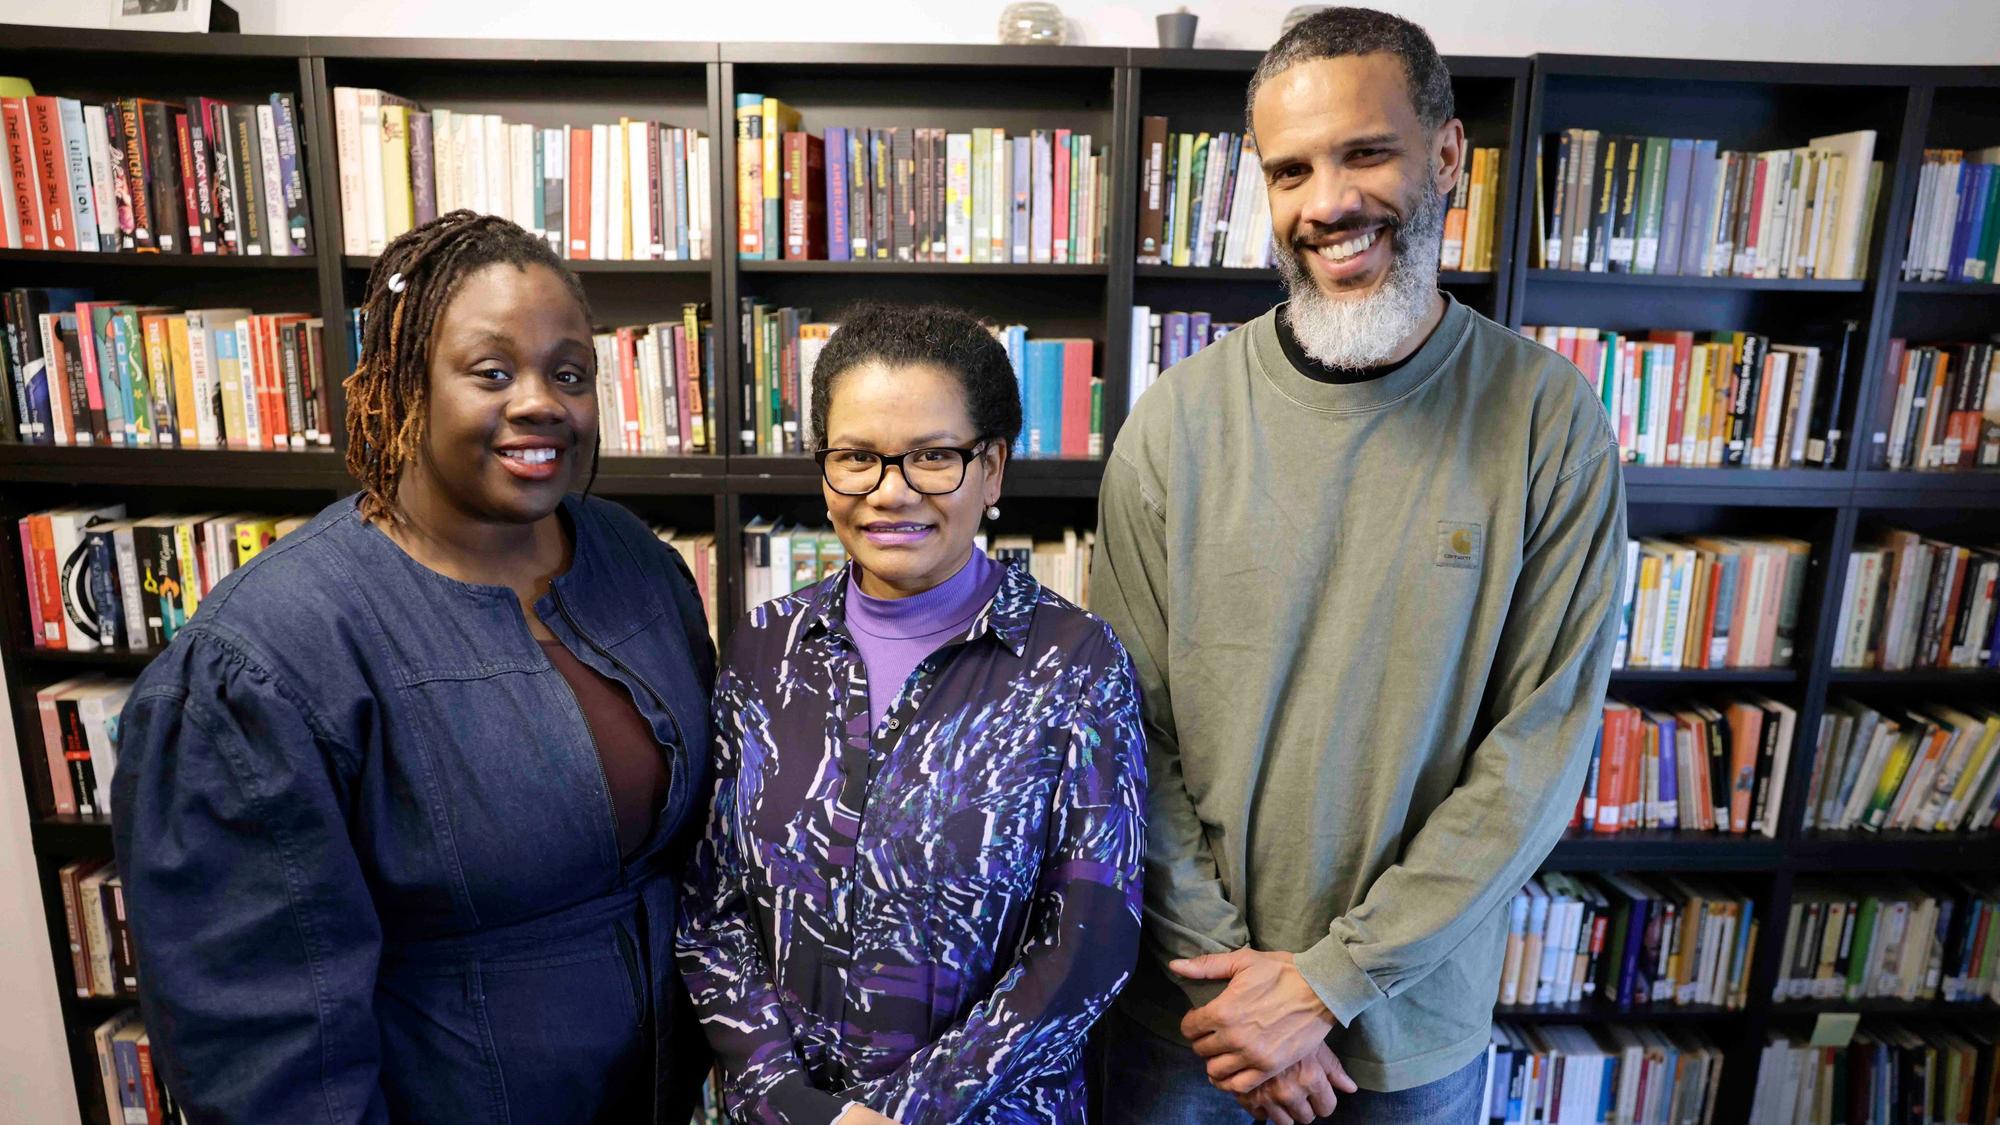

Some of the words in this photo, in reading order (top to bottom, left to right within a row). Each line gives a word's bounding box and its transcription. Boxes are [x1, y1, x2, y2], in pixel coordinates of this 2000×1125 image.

[7, 115, 20, 140] THE
[36, 105, 49, 133] GIVE
[123, 112, 137, 138] BAD
[41, 138, 51, 146] U
[12, 145, 26, 178] HATE
[43, 149, 54, 178] HATE
[127, 140, 143, 177] WITCH
[193, 140, 207, 178] BLACK
[17, 183, 27, 191] U
[48, 184, 58, 205] THE
[76, 184, 89, 215] LION
[198, 178, 211, 214] VEINS
[19, 195, 32, 226] GIVE
[131, 178, 149, 229] BURNING
[831, 162, 845, 243] AMERICANAH
[149, 322, 160, 343] THE
